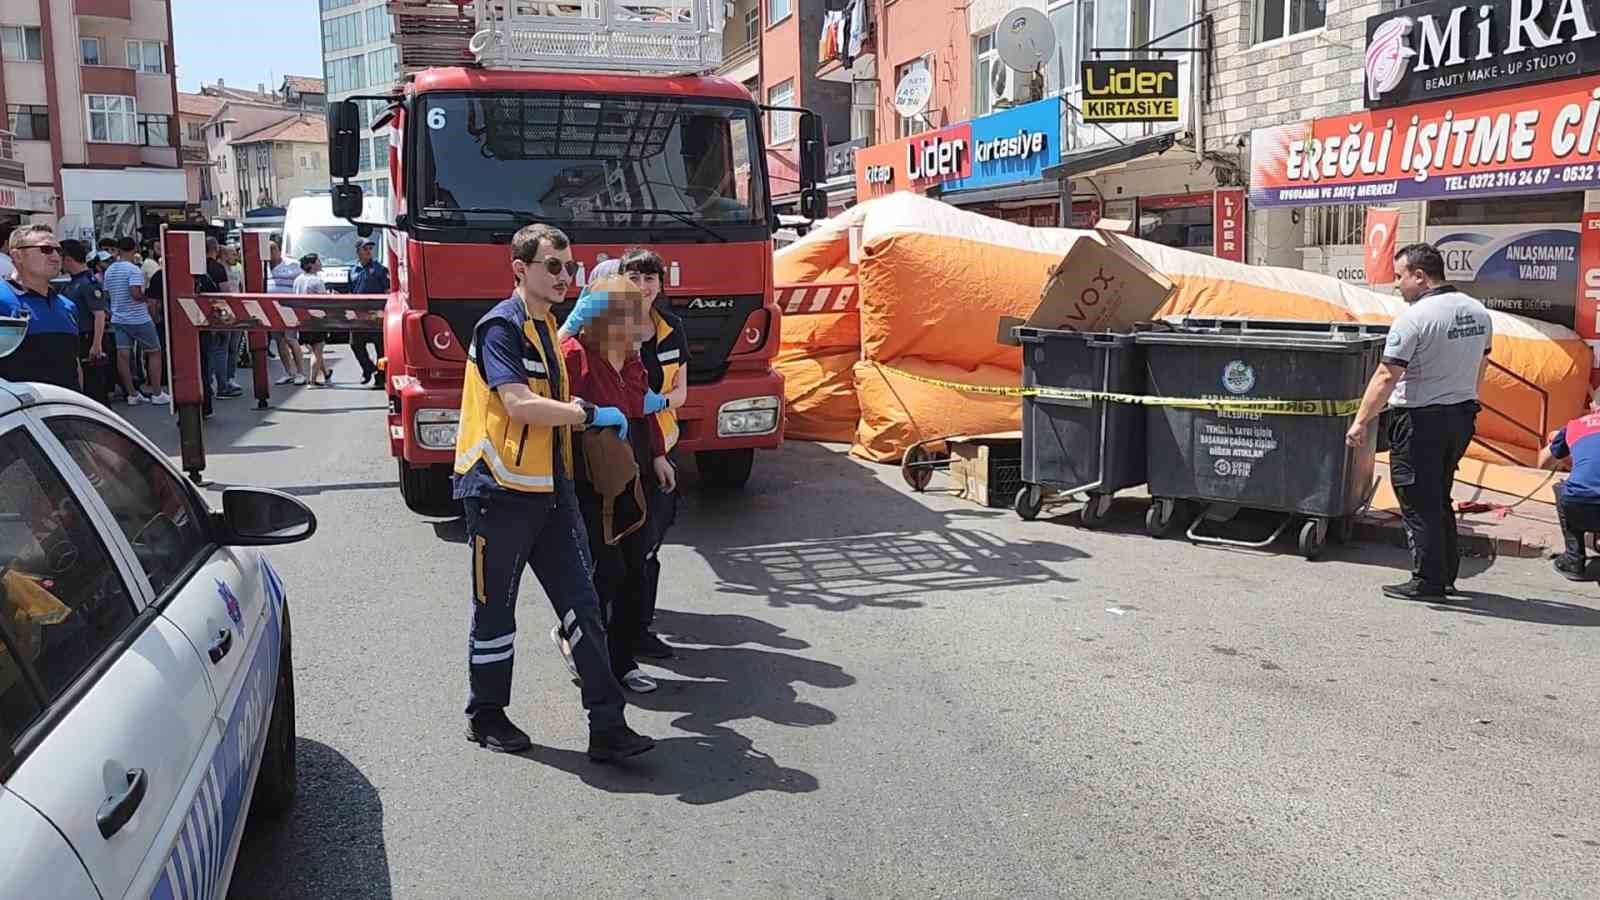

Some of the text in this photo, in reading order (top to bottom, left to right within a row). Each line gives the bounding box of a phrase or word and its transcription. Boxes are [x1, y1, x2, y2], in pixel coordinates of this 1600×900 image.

[1086, 67, 1173, 95] Lider
[1425, 73, 1464, 90] BEAUTY
[1467, 66, 1497, 81] MAKE
[1508, 62, 1522, 75] UP
[1526, 52, 1576, 71] STÜDYO
[427, 107, 446, 130] 6
[1287, 87, 1600, 183] EREĞLİ İŞİTME Cİ
[865, 128, 1043, 184] kitap Lider kırtasiye
[1280, 181, 1397, 200] UYGULAMA VE SATIŞ MERKEZİ
[1445, 175, 1467, 191] TEL:
[1469, 172, 1494, 188] 0372
[1496, 171, 1516, 186] 316
[1535, 168, 1551, 184] 67
[1563, 165, 1593, 182] 0532
[1506, 246, 1575, 264] ANLAŞMAMIZ
[1519, 264, 1557, 281] VARDIR
